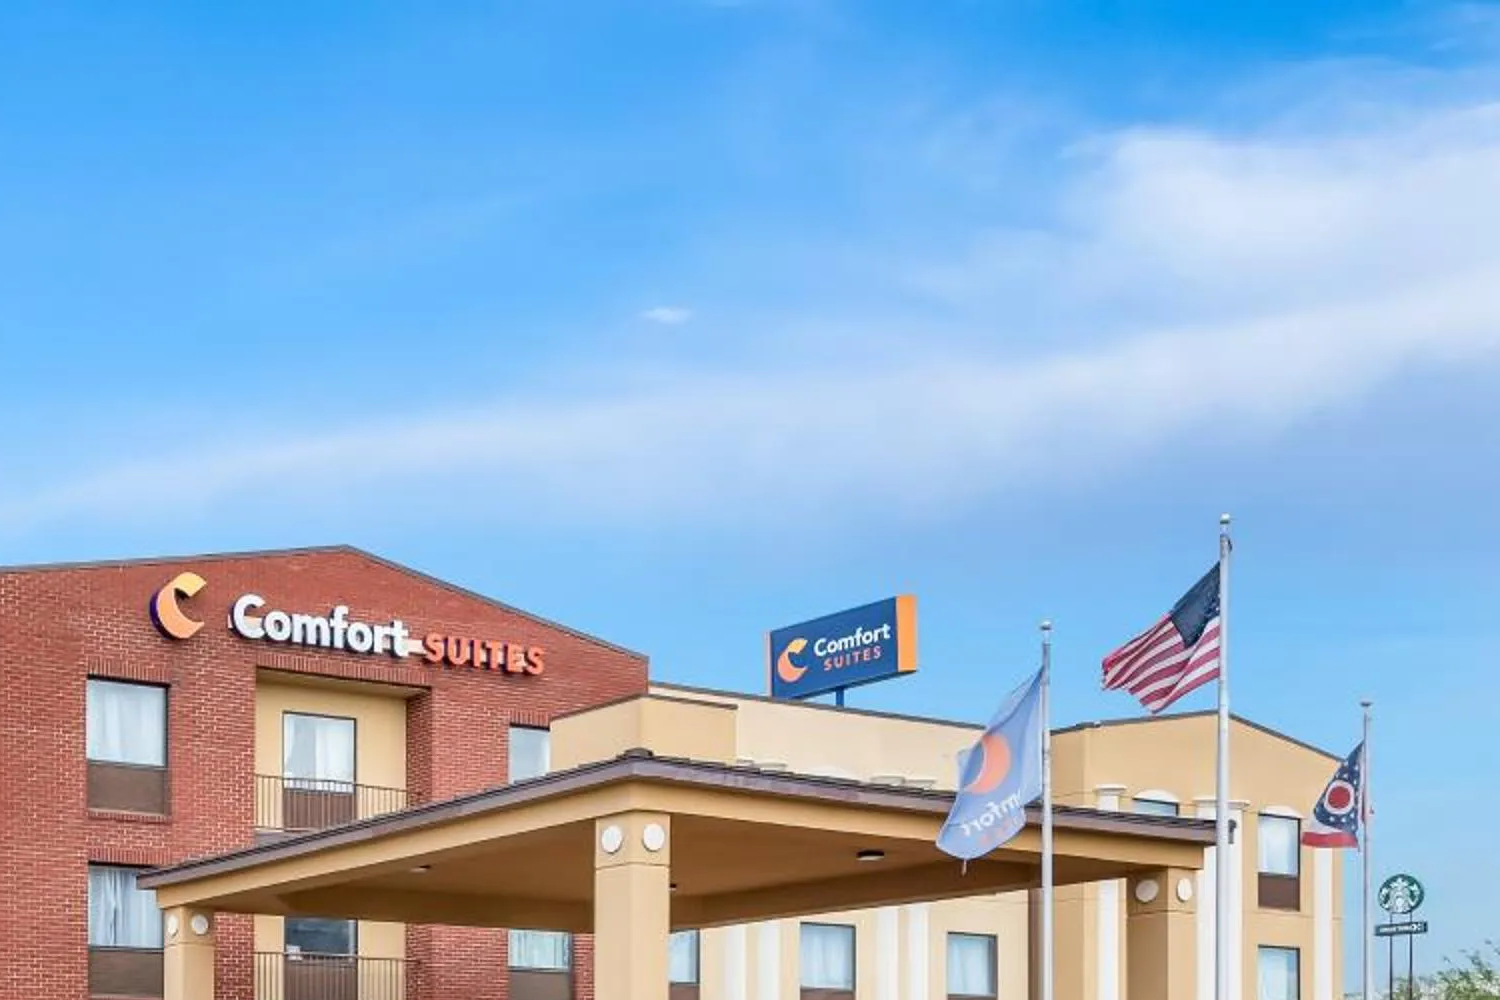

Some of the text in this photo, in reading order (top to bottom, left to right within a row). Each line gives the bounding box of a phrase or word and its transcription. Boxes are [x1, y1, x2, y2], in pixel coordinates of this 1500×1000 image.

[232, 593, 544, 675] Comfort SUITES
[813, 623, 891, 657] Comfort
[823, 645, 882, 671] SUITES
